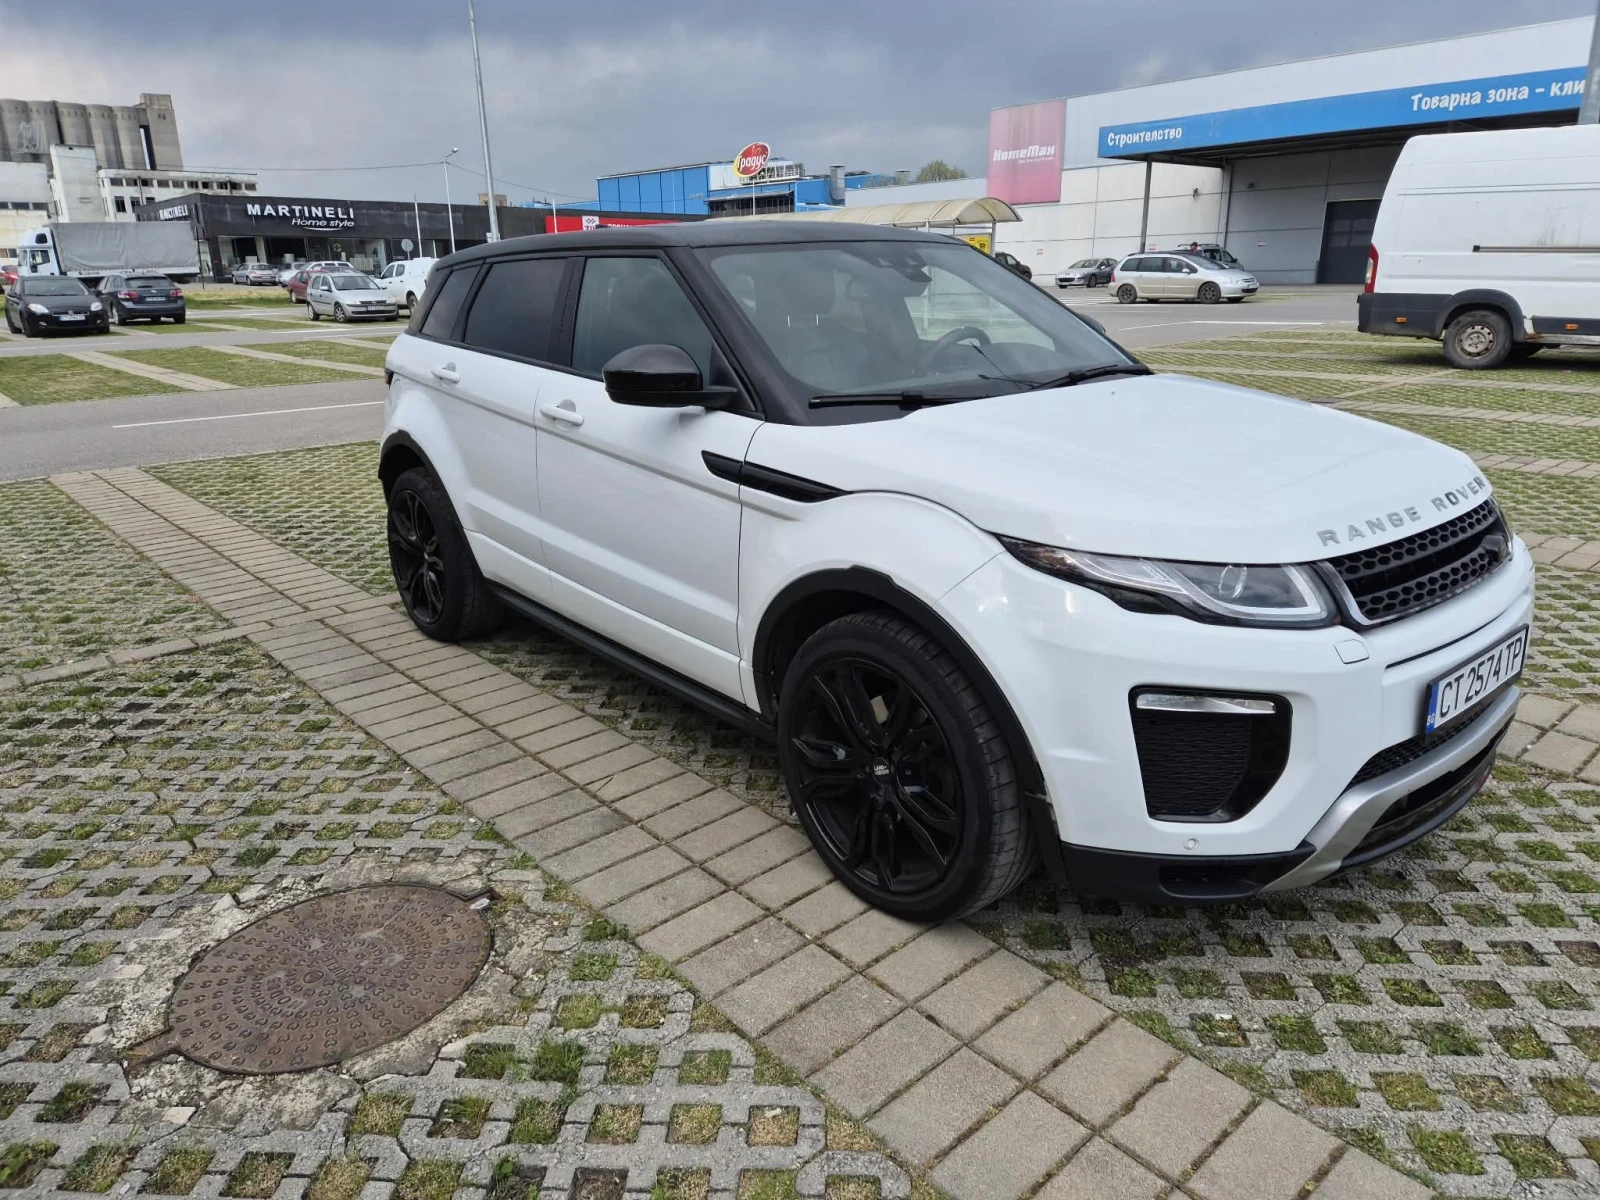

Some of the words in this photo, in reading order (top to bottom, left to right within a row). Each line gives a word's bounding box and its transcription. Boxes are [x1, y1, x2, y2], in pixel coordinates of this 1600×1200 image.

[1411, 93, 1481, 111] Товарна
[1486, 86, 1529, 104] зона
[1107, 127, 1183, 147] Строителство
[737, 154, 768, 172] Градус
[246, 203, 354, 219] MARTINELI
[291, 218, 327, 227] Home
[329, 219, 355, 229] style
[1316, 506, 1422, 547] RANGE
[1430, 475, 1486, 512] ROVER
[1440, 672, 1465, 718] CT
[1464, 648, 1503, 704] 2574
[1505, 636, 1523, 676] TP
